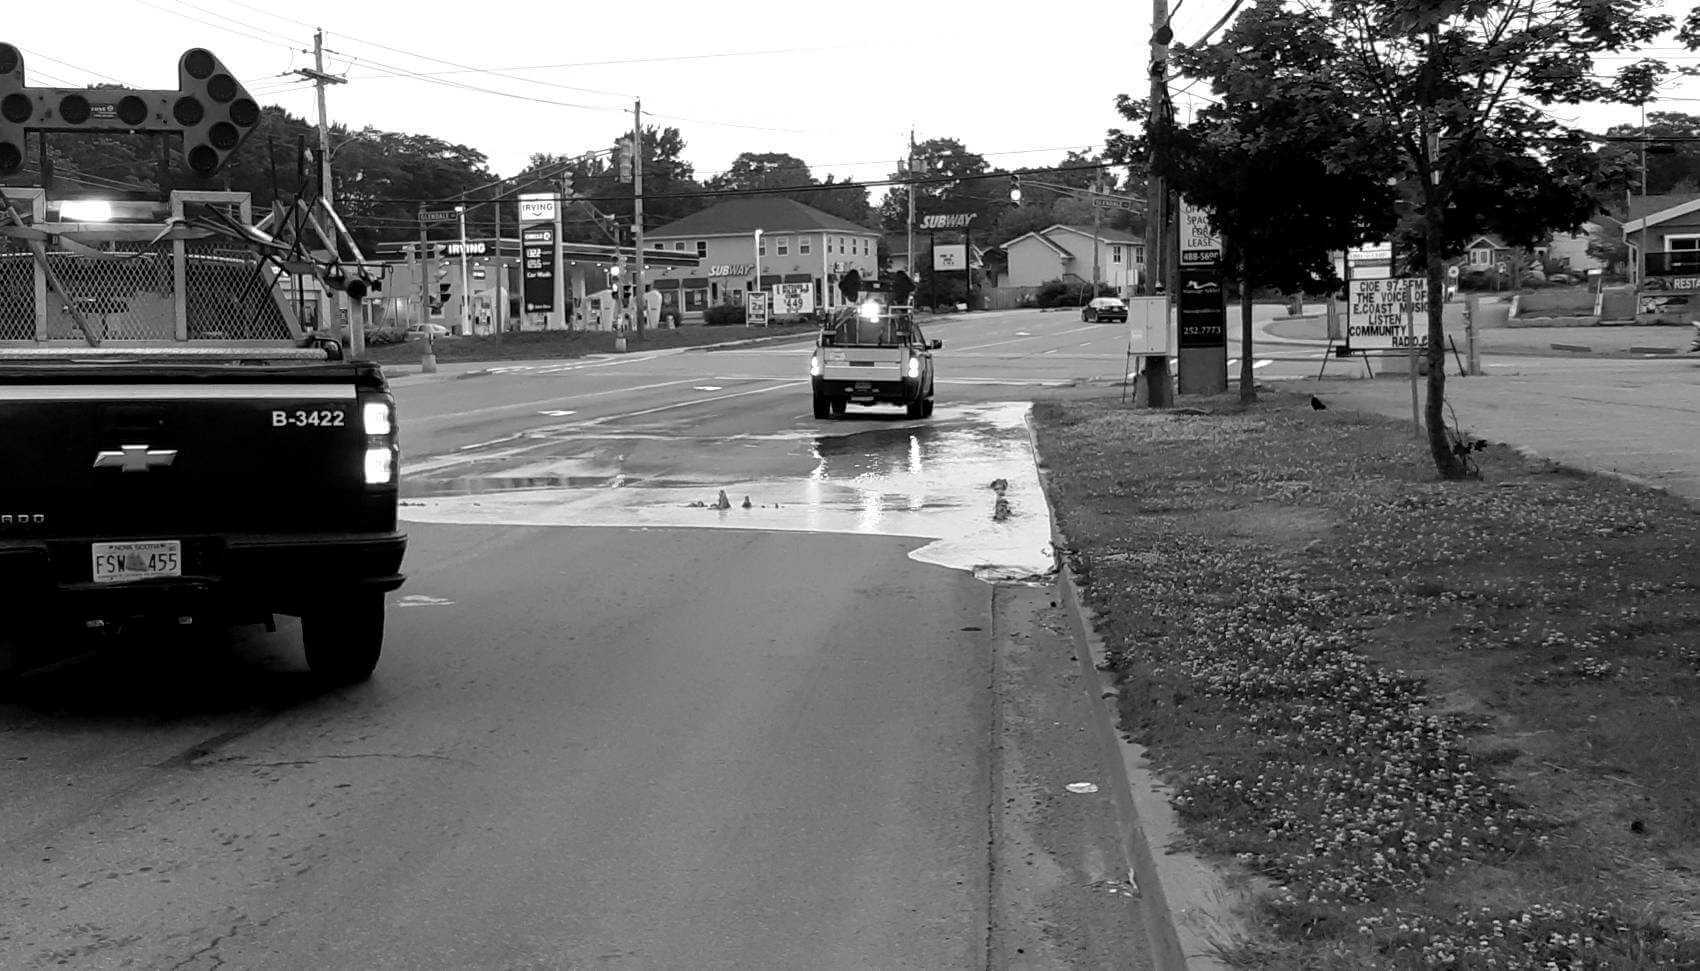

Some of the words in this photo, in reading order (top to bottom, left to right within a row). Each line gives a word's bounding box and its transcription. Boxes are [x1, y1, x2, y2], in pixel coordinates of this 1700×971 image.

[522, 202, 553, 211] IRVING
[920, 213, 977, 228] SUBWAY
[1186, 215, 1210, 225] SPAC
[448, 243, 486, 255] IRVING
[1187, 238, 1212, 248] LEASE
[708, 264, 756, 277] SUBWAY
[1356, 292, 1375, 303] THE
[1380, 291, 1407, 303] VOICE
[1414, 290, 1427, 301] OF
[1368, 314, 1401, 325] LISTEN
[1349, 326, 1407, 337] COMMUNITY
[272, 410, 345, 427] B-3422
[96, 555, 126, 574] FSW
[148, 553, 177, 572] 455
